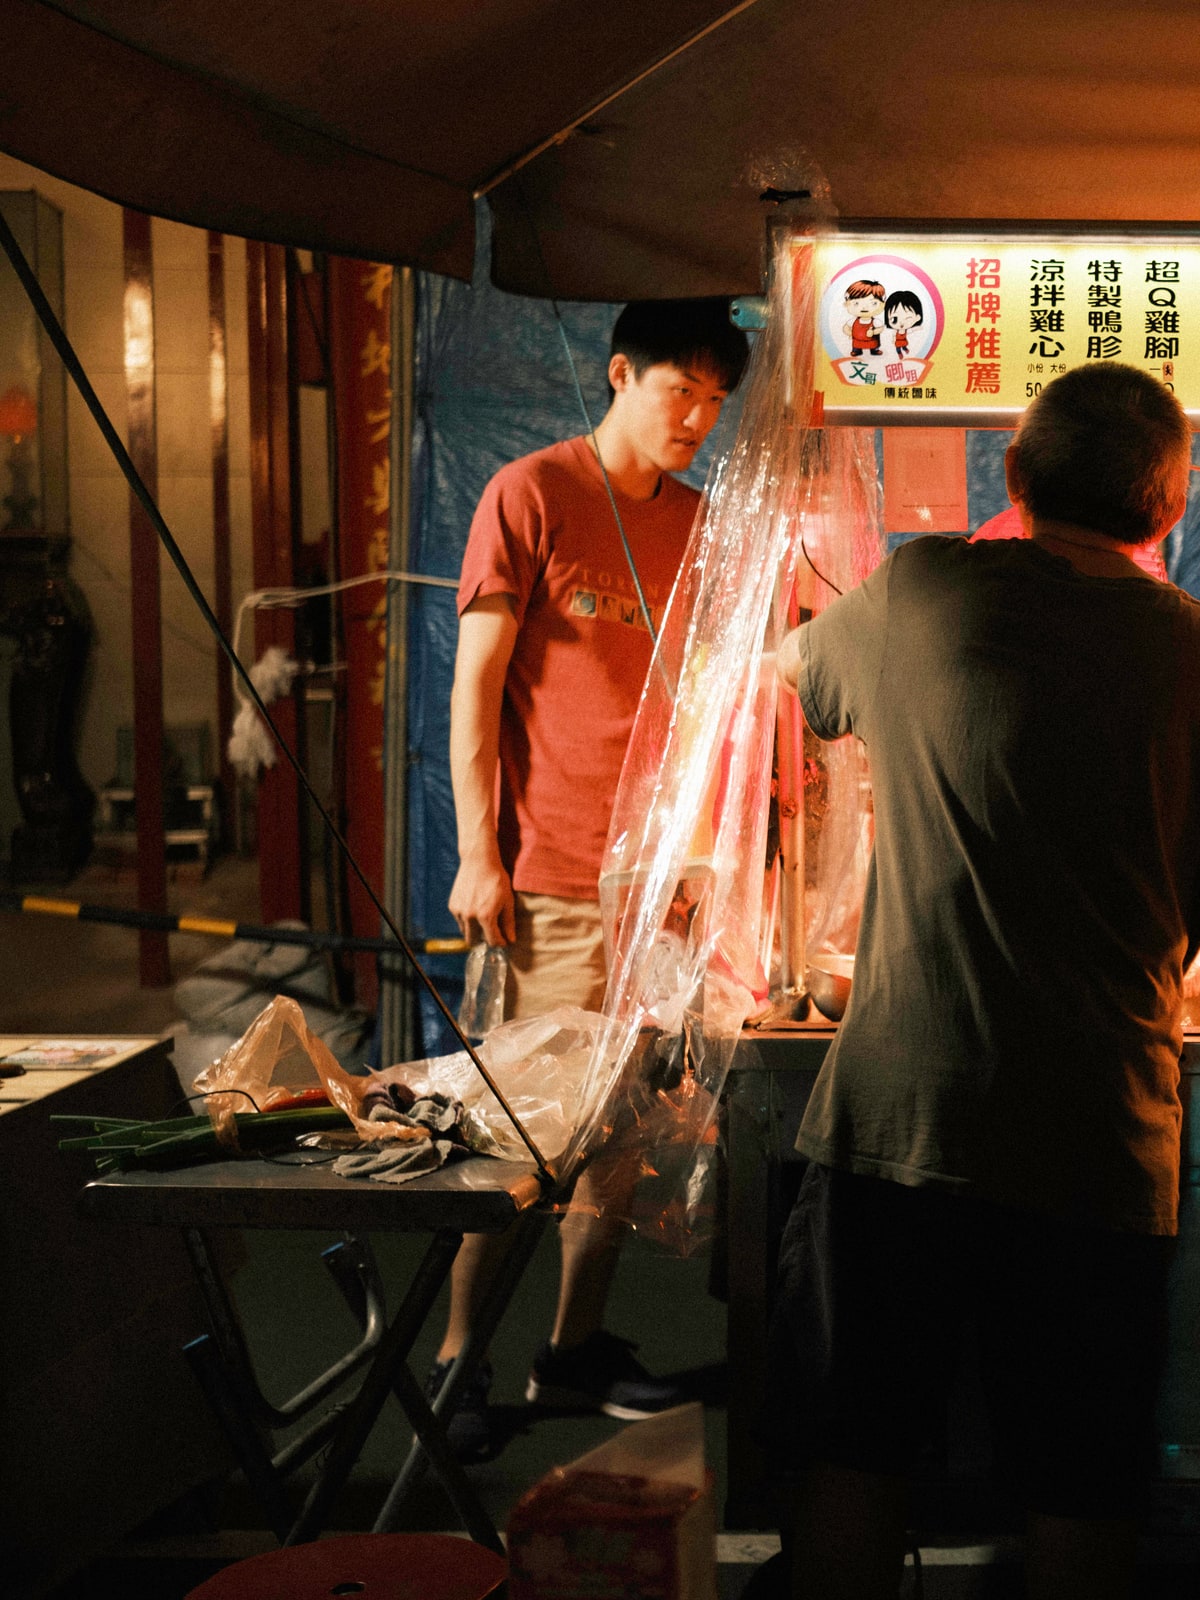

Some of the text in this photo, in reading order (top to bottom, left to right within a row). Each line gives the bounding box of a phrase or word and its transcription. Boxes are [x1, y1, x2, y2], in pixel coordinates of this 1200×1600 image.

[965, 257, 1001, 394] 招牌推薦
[1029, 259, 1065, 358] 涼拌雞心
[1086, 259, 1123, 359] 特製鴨胗
[1144, 260, 1180, 359] 超Q雞腳
[849, 361, 877, 385] 文哥
